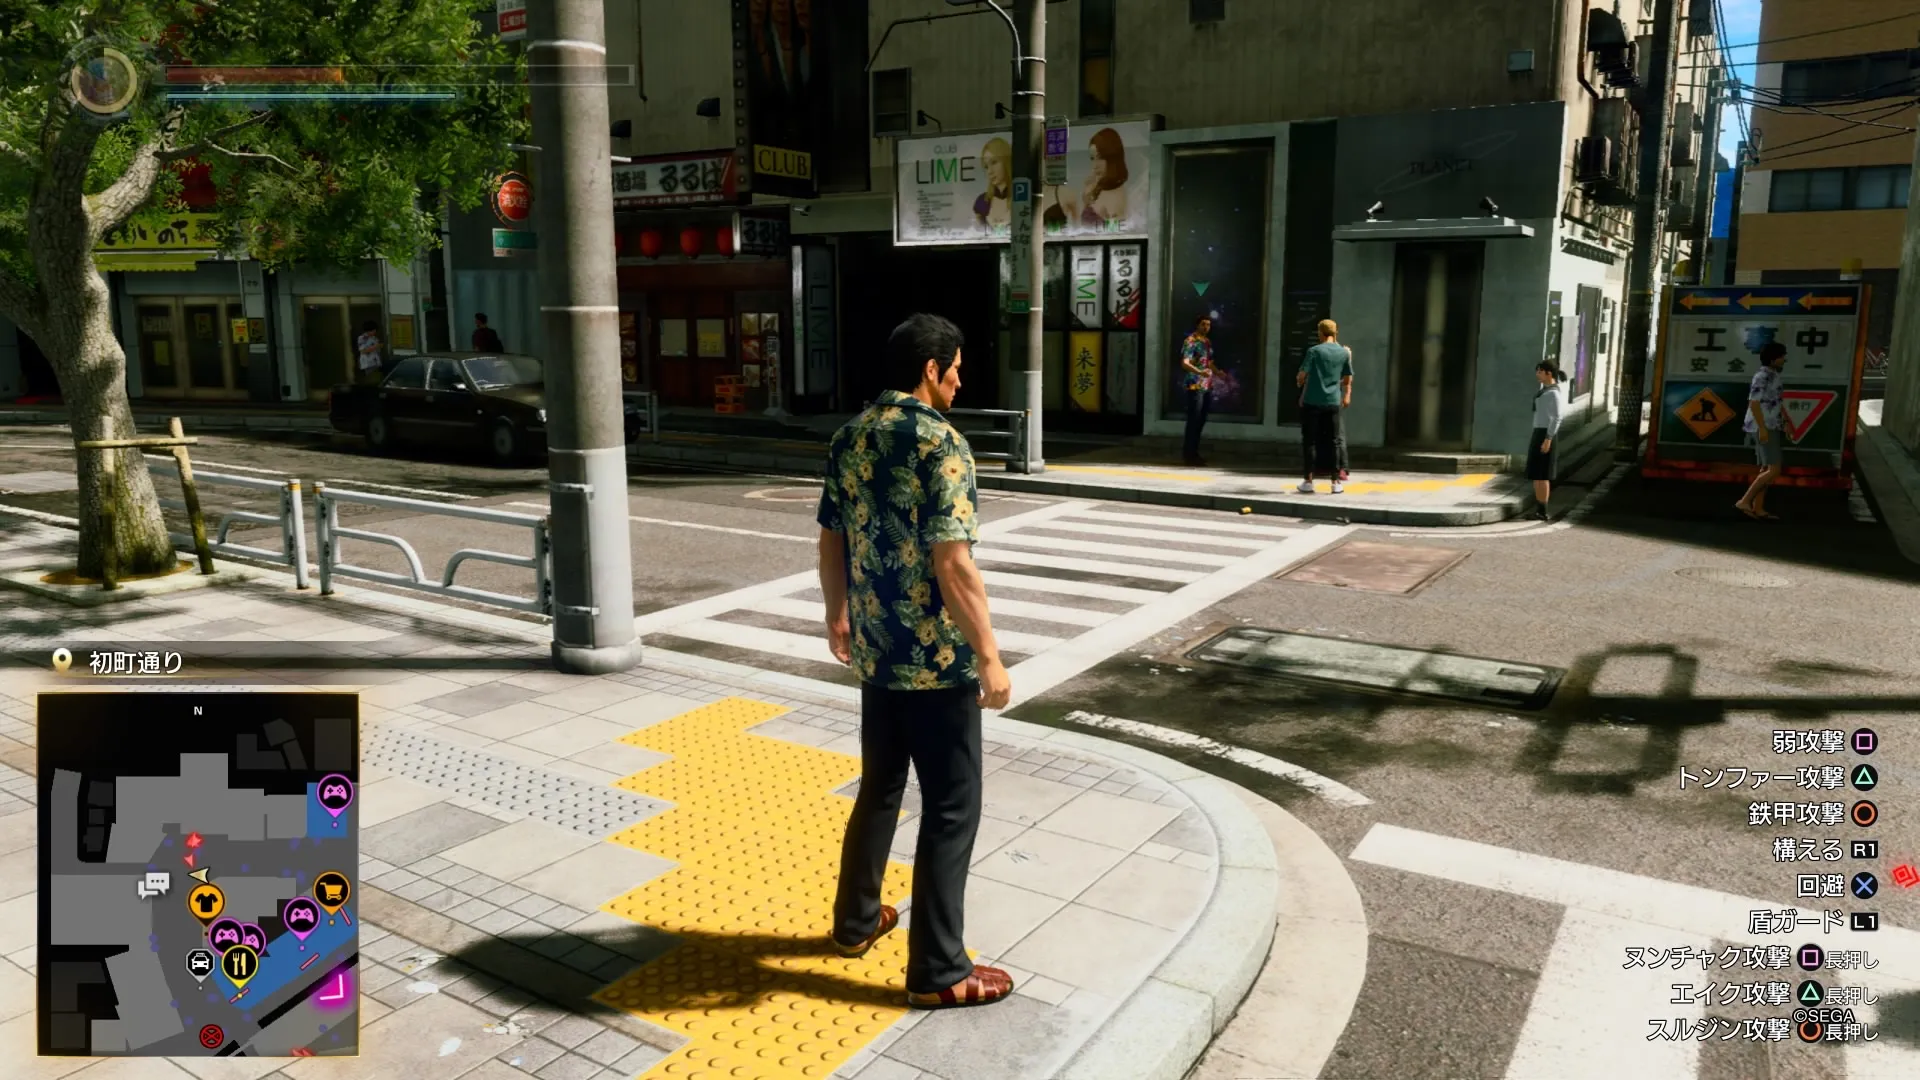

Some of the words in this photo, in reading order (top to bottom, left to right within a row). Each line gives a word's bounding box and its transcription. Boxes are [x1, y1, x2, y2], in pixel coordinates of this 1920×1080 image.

[758, 150, 808, 177] CLUB
[916, 156, 976, 184] LIME
[1409, 157, 1473, 175] PLANET
[1075, 257, 1097, 317] LIME
[810, 283, 830, 370] LIME
[1075, 347, 1096, 395] 来夢
